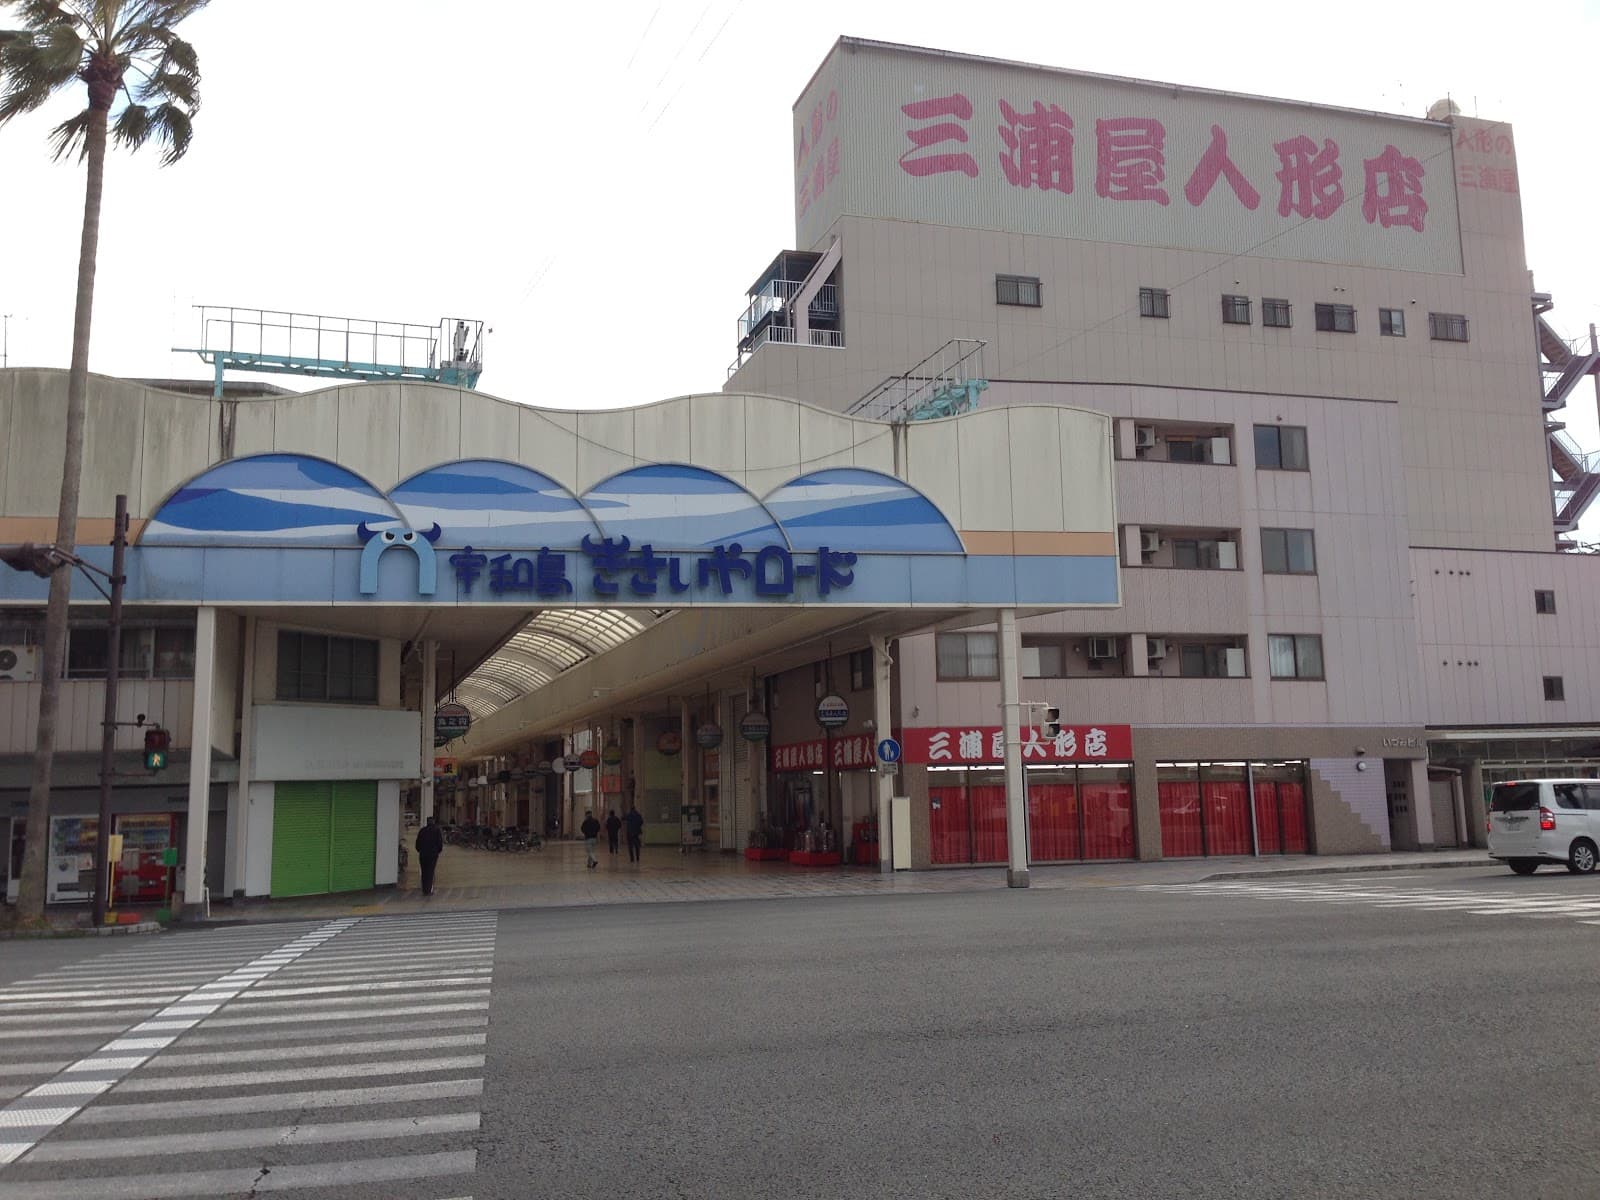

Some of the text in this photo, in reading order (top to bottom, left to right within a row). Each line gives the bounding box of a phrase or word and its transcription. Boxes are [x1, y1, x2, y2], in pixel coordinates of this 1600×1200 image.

[899, 92, 1430, 232] 三浦屋人形店
